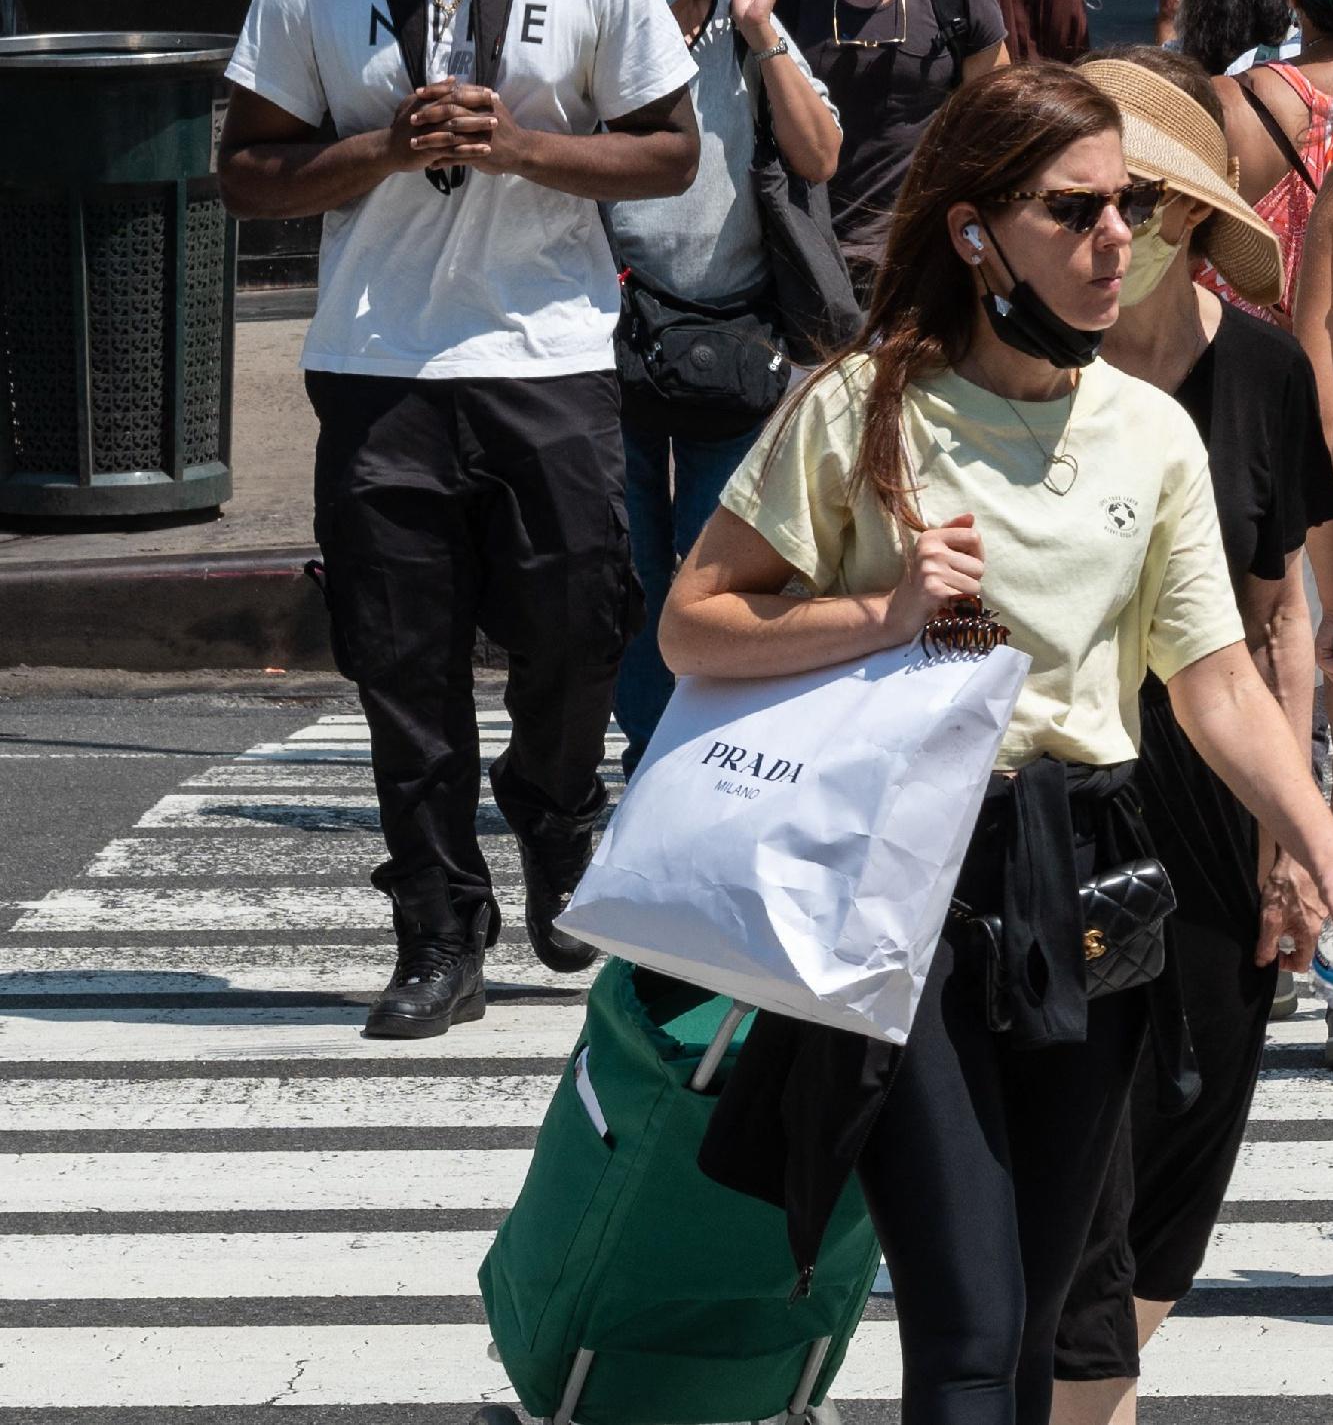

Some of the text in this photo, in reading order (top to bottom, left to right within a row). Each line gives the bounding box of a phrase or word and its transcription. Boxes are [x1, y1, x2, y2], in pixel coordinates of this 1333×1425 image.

[370, 3, 548, 46] NIE
[701, 741, 804, 784] PRADA
[714, 779, 761, 800] MILANO
